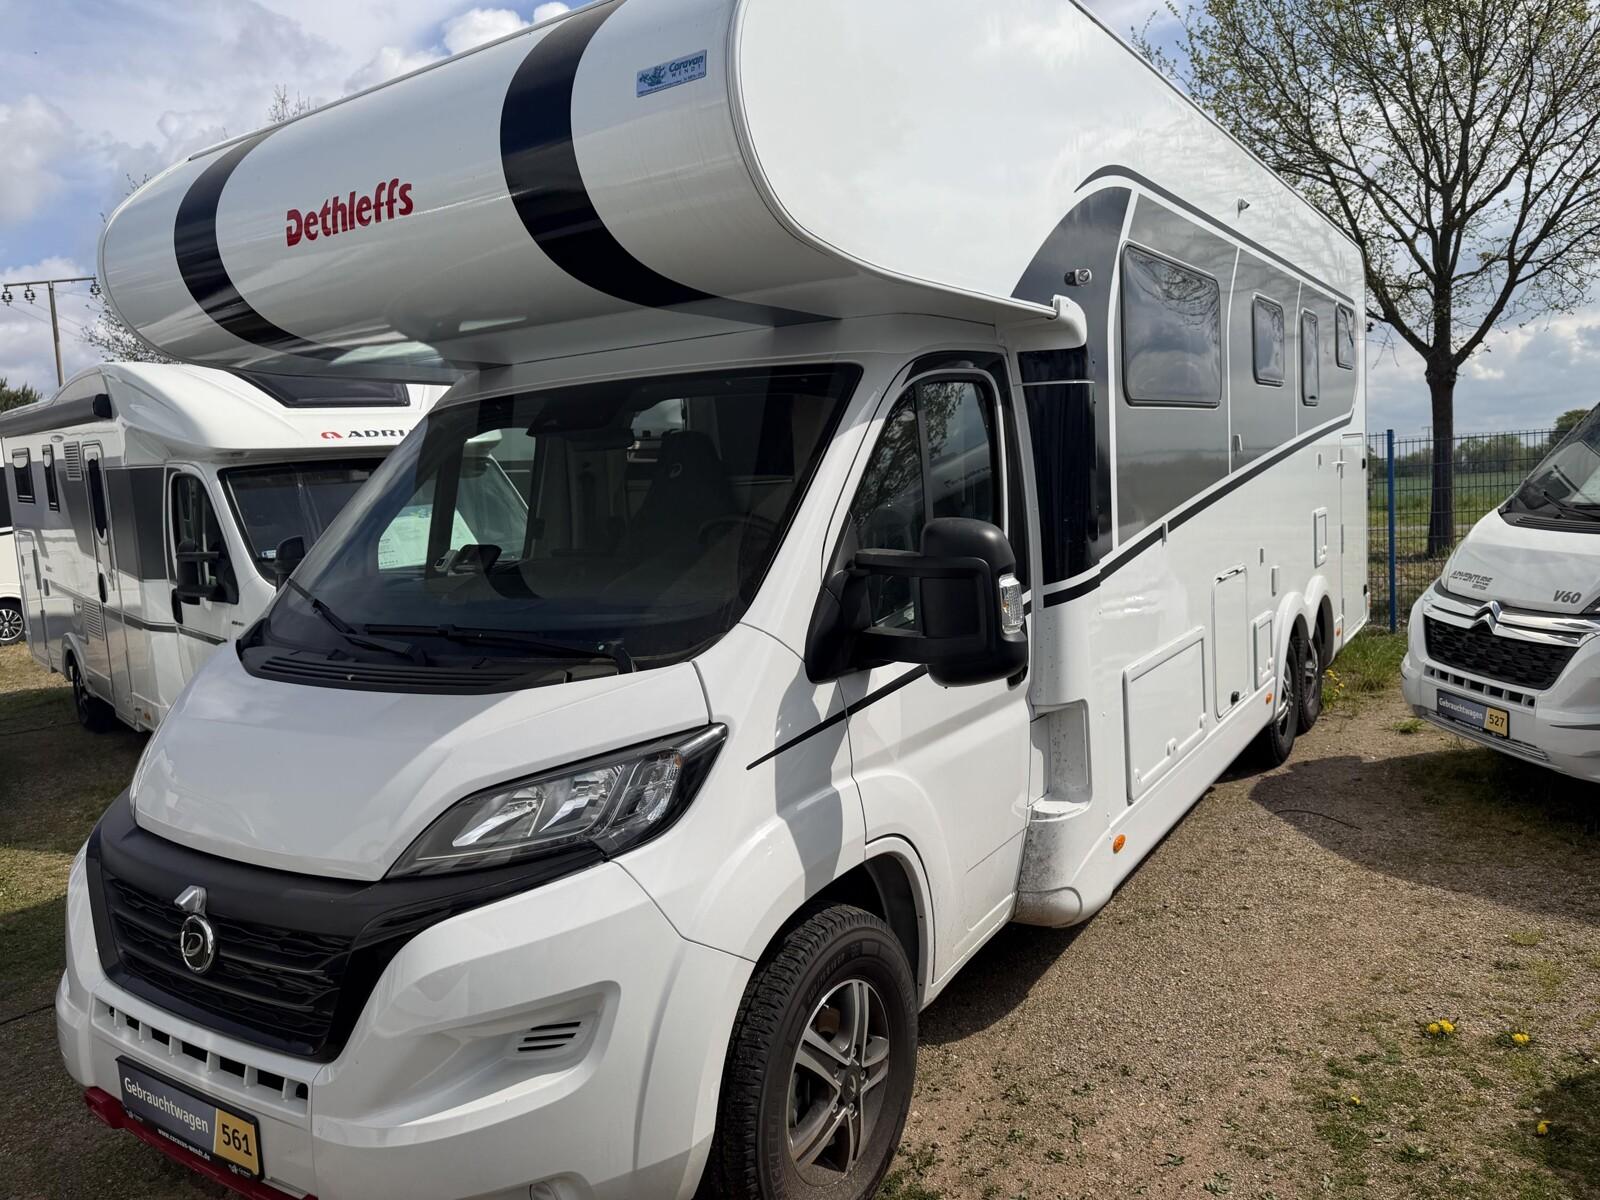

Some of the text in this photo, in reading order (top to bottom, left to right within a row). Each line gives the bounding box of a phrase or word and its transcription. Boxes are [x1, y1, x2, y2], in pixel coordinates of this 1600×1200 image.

[286, 177, 414, 247] Dethleffs
[348, 429, 412, 439] ADRI
[1553, 590, 1582, 604] V60
[1438, 697, 1483, 720] Gebrauchtwagen
[1489, 713, 1505, 728] 527
[124, 1077, 253, 1157] Gebrauchtwagen 561
